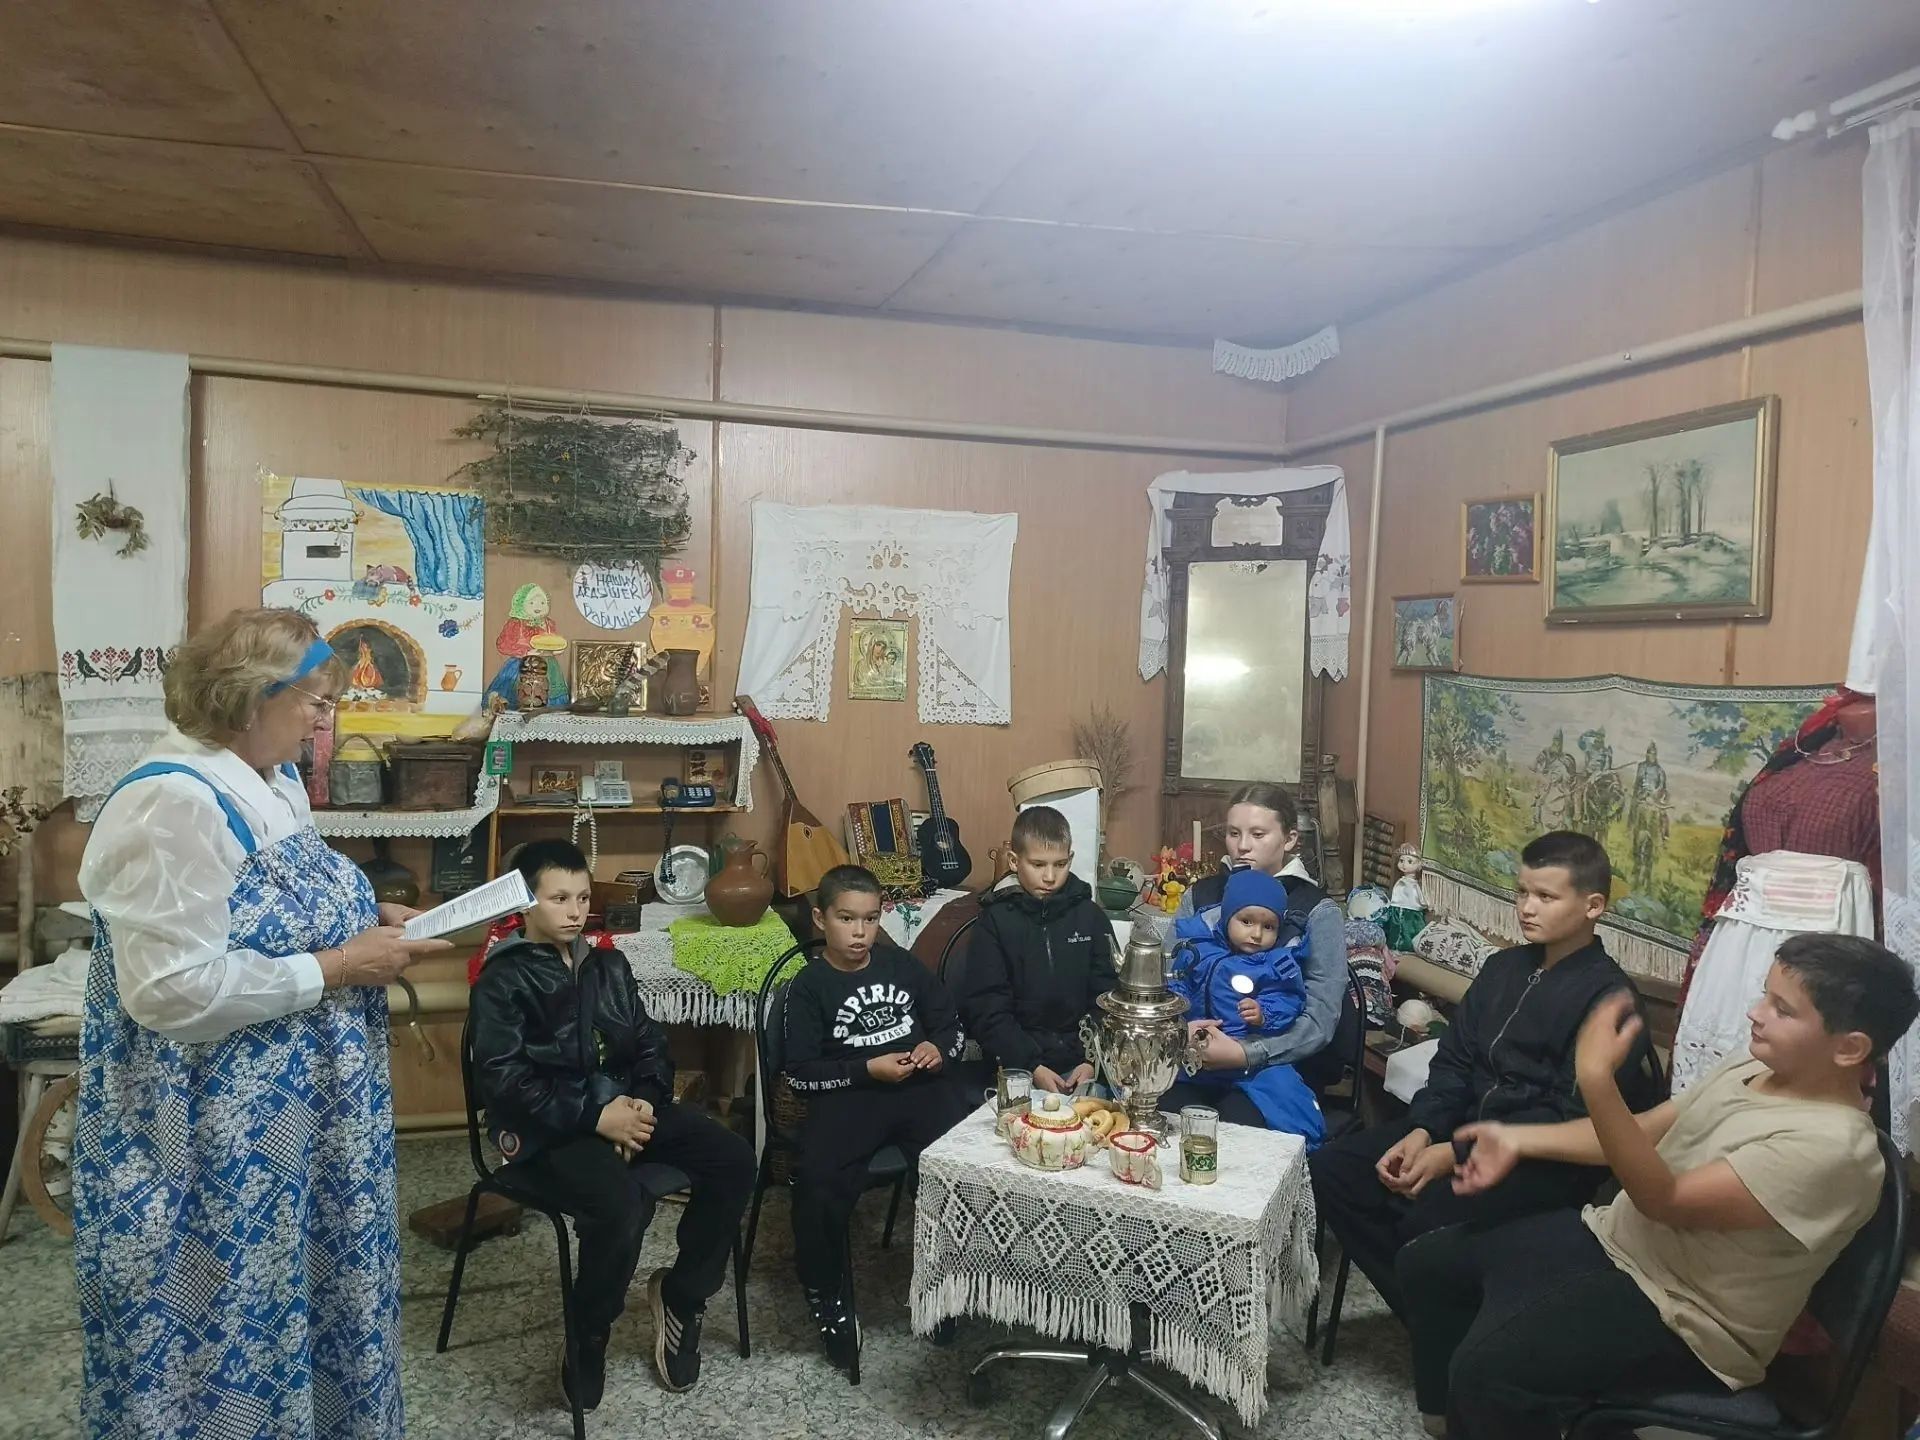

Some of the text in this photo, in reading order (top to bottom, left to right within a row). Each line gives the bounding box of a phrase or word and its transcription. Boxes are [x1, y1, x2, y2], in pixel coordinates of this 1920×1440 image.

[596, 573, 636, 589] НАШИХ
[575, 585, 642, 601] ДЕДУШЕК
[861, 1026, 906, 1046] VINTAGE
[809, 1080, 819, 1091] IN
